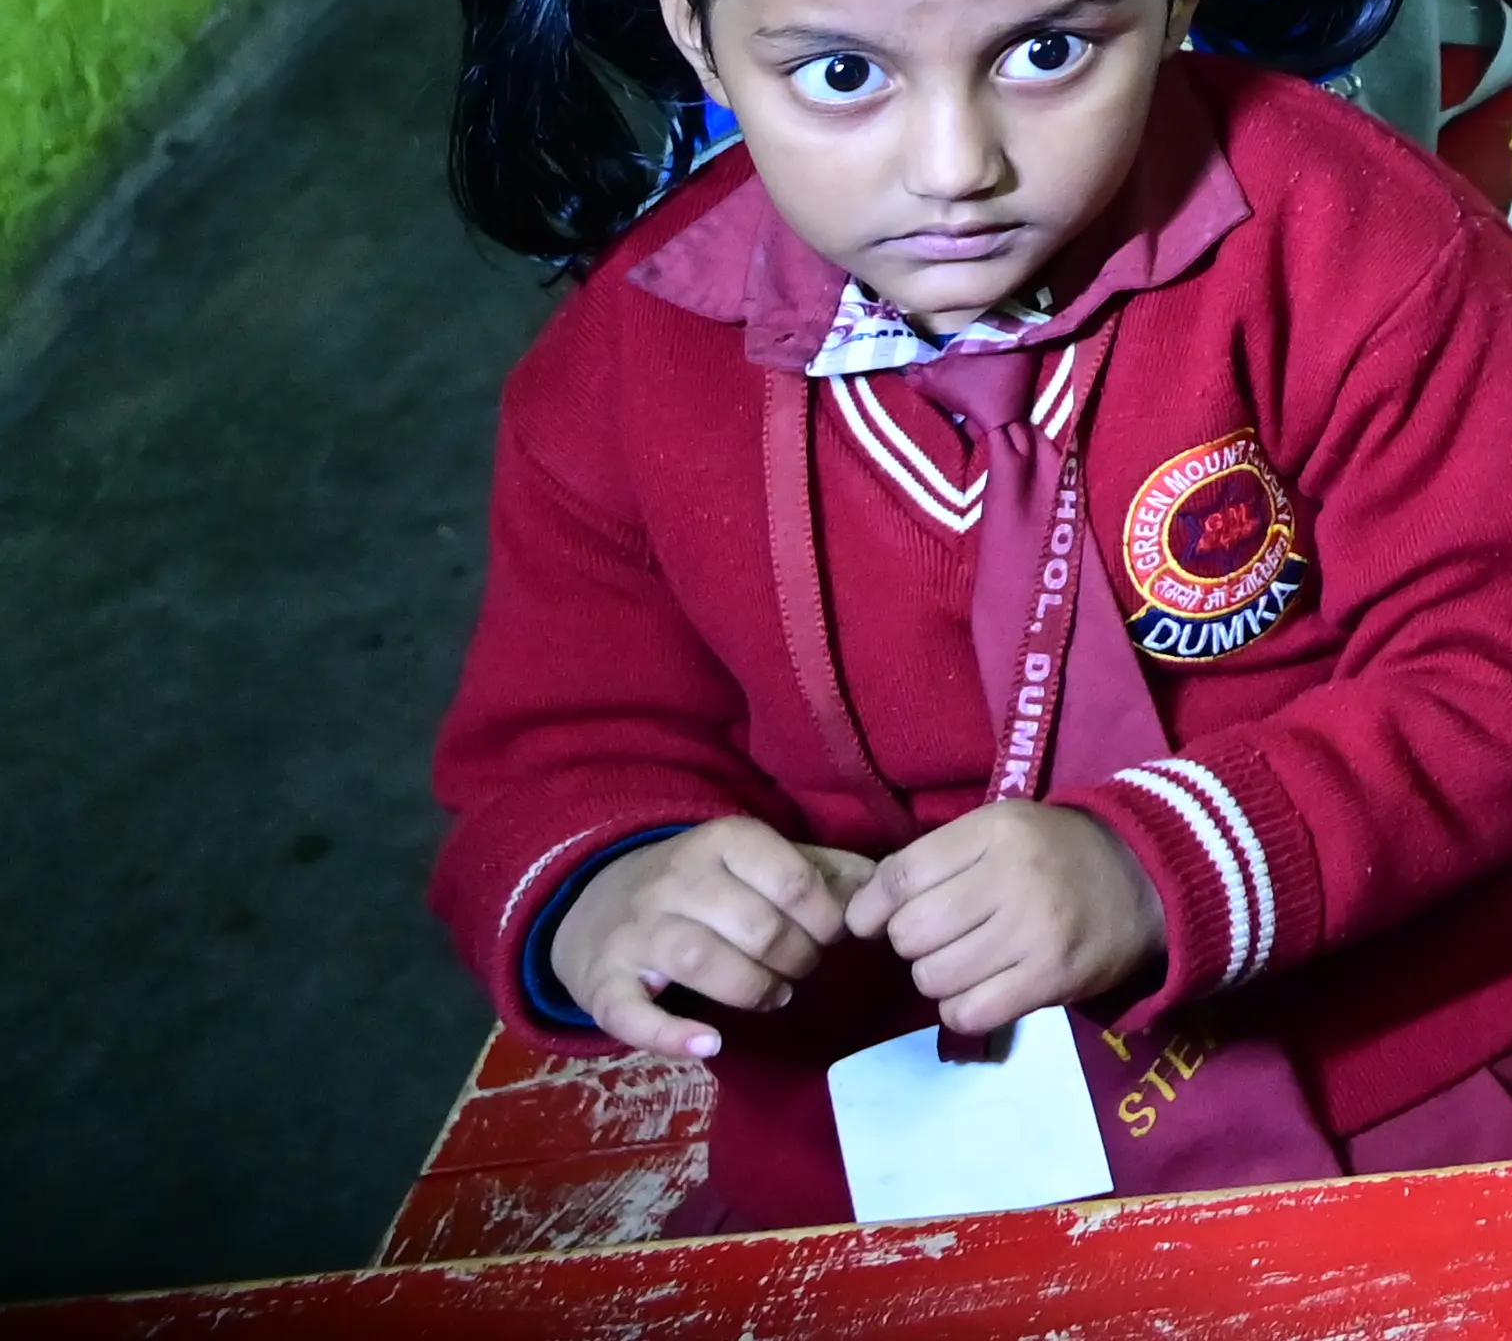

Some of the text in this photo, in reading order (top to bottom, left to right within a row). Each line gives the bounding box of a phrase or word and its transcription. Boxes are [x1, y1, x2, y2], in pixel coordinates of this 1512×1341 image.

[1133, 490, 1173, 571] GREEN
[1164, 439, 1246, 500] MOUNT
[1143, 580, 1300, 656] DUMKA
[997, 652, 1052, 802] DUMK
